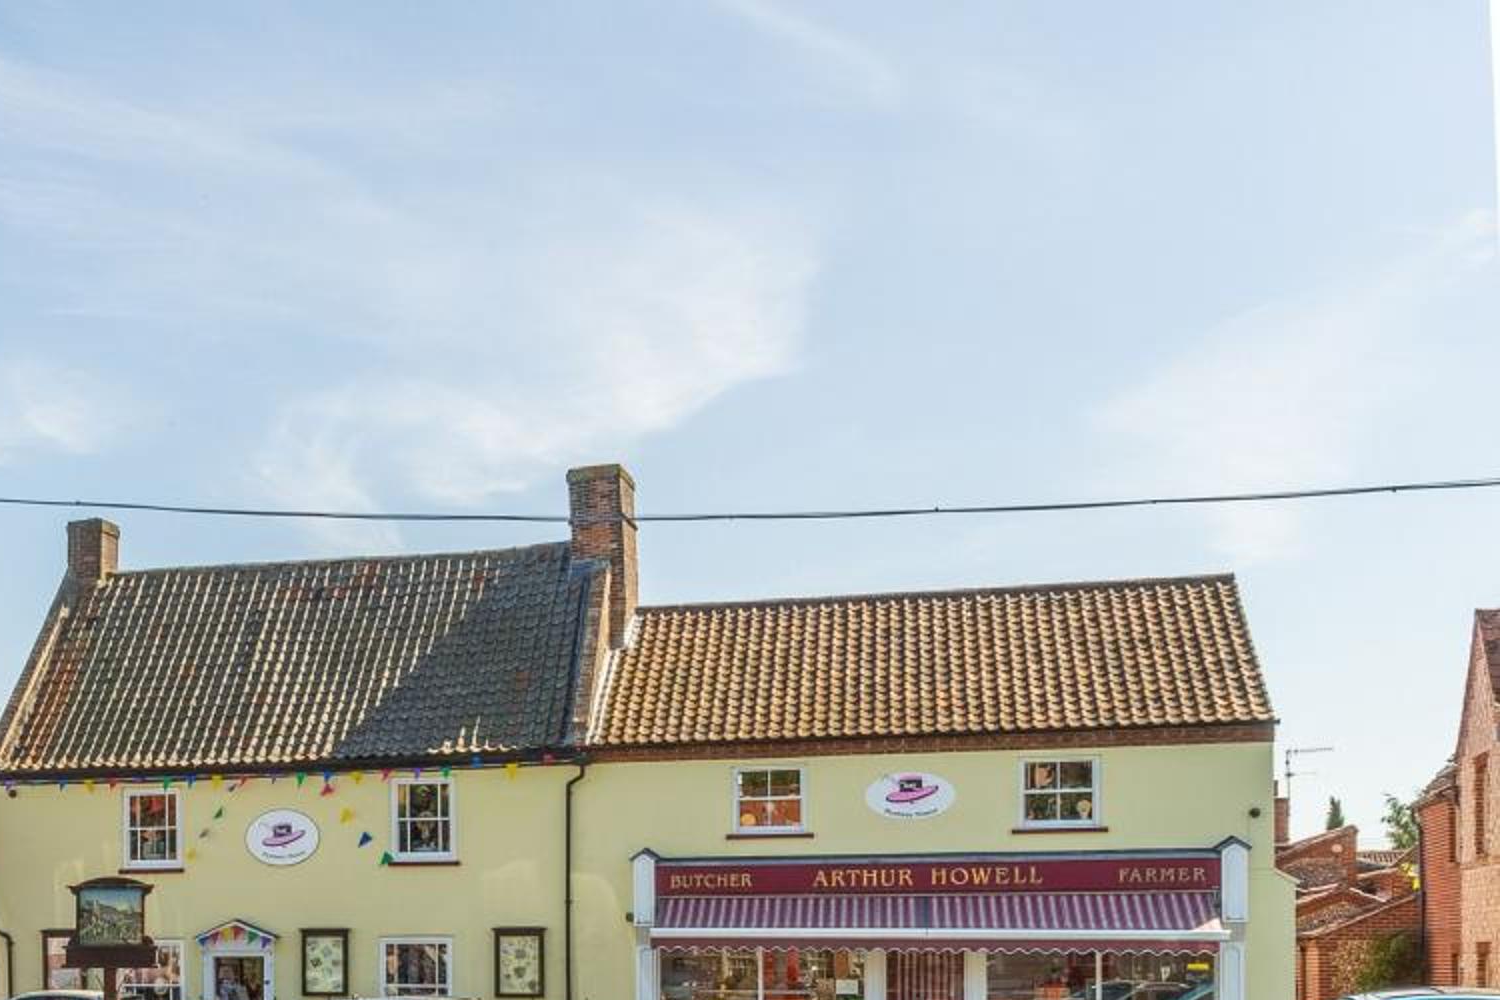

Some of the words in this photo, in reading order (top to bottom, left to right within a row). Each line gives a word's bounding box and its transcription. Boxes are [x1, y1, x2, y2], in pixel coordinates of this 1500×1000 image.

[670, 873, 753, 889] BUTCHER
[812, 868, 914, 888] ARTHUR
[931, 866, 1044, 886] HOWELL
[1118, 867, 1207, 884] FARMER
